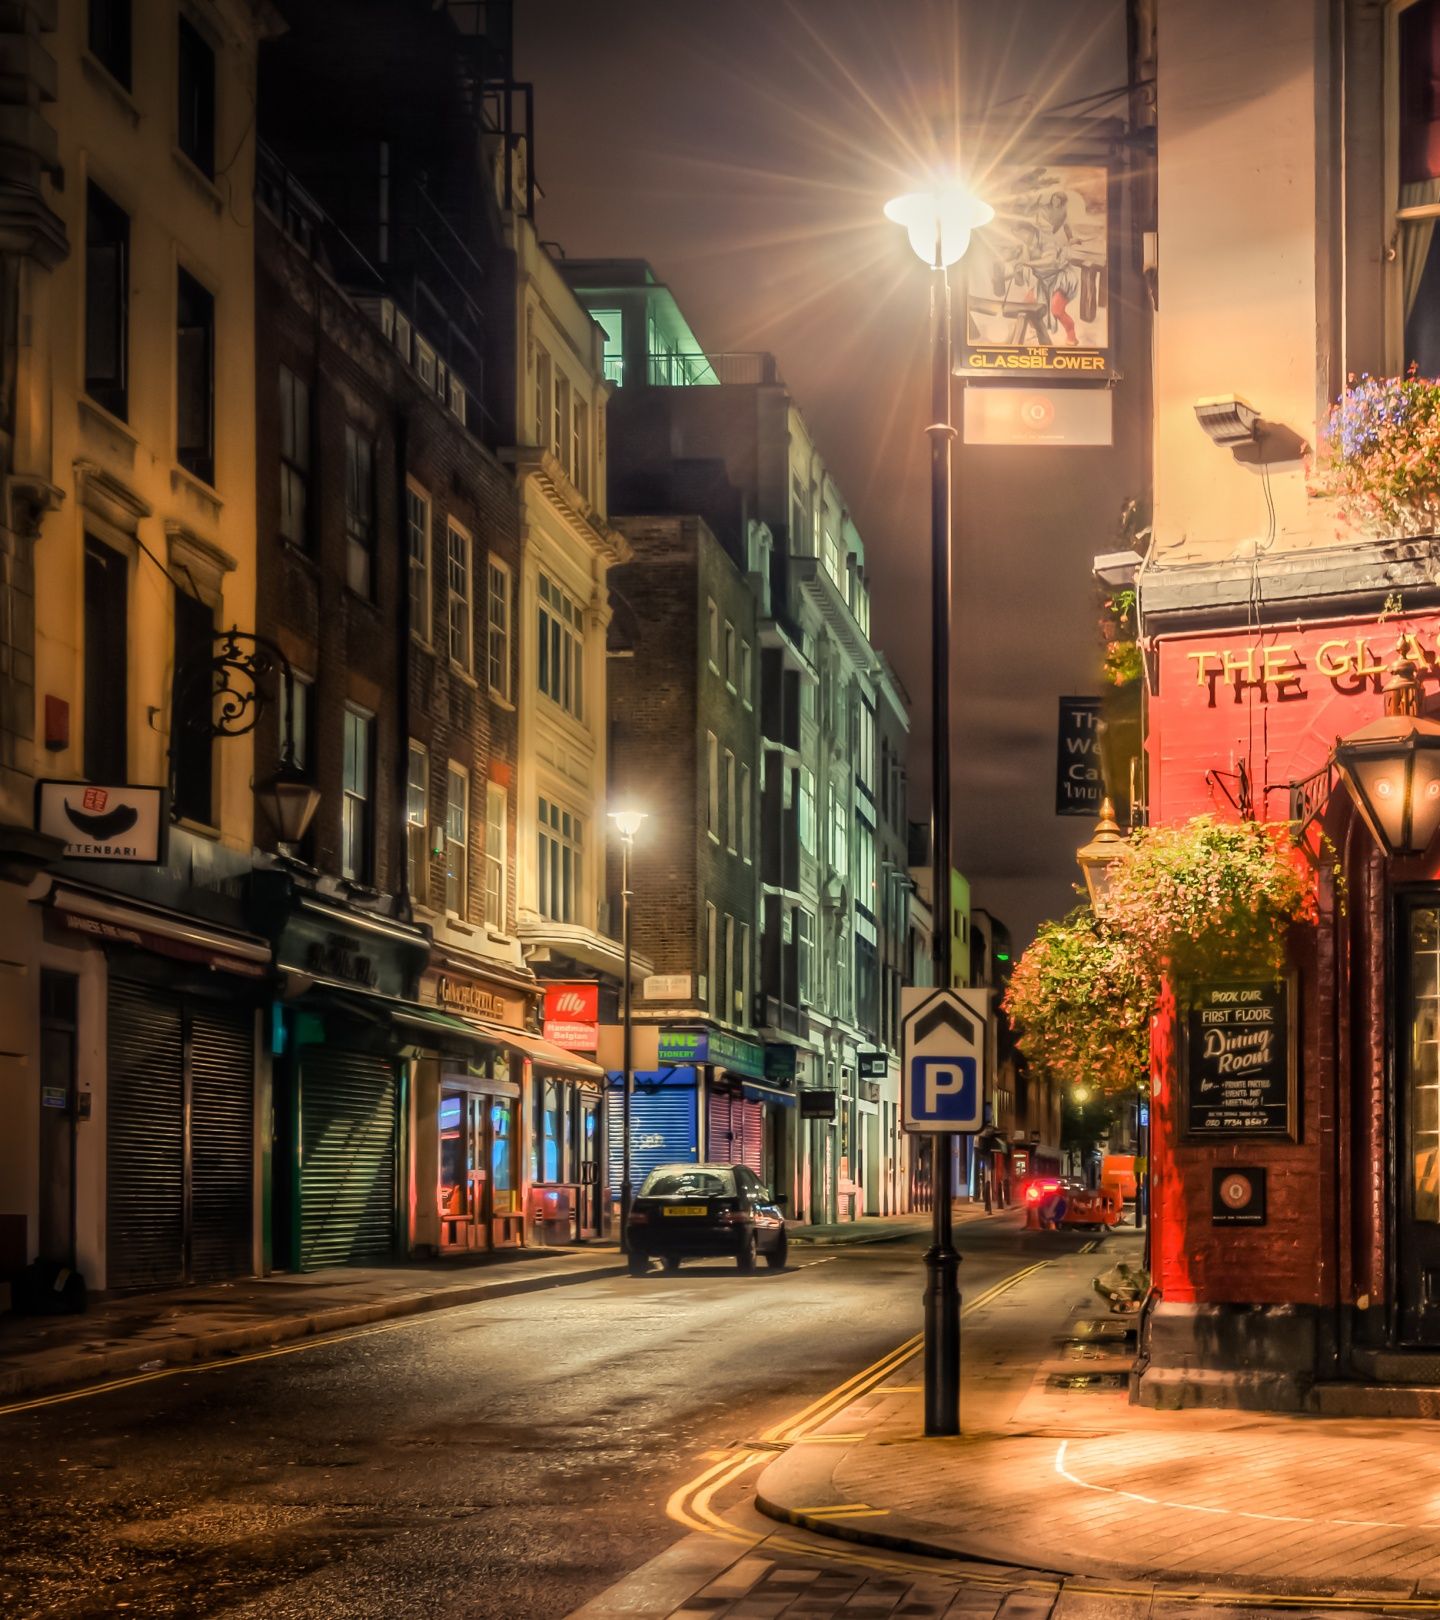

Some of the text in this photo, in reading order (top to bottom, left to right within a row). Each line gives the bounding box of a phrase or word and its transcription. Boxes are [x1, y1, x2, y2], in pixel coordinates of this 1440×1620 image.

[1027, 347, 1049, 356] THE
[969, 354, 1105, 370] GLASSBLOWER
[1187, 644, 1296, 687] THE
[67, 844, 137, 856] TTENBARI
[556, 992, 586, 1016] illy
[1211, 990, 1263, 1003] BOOK OUR
[1202, 1008, 1272, 1022] FIRST FLOOR
[551, 1040, 595, 1048] hocolates
[1203, 1028, 1274, 1058] Dining
[659, 1050, 695, 1058] TIONERY
[1218, 1048, 1273, 1074] Room
[924, 1063, 965, 1113] P
